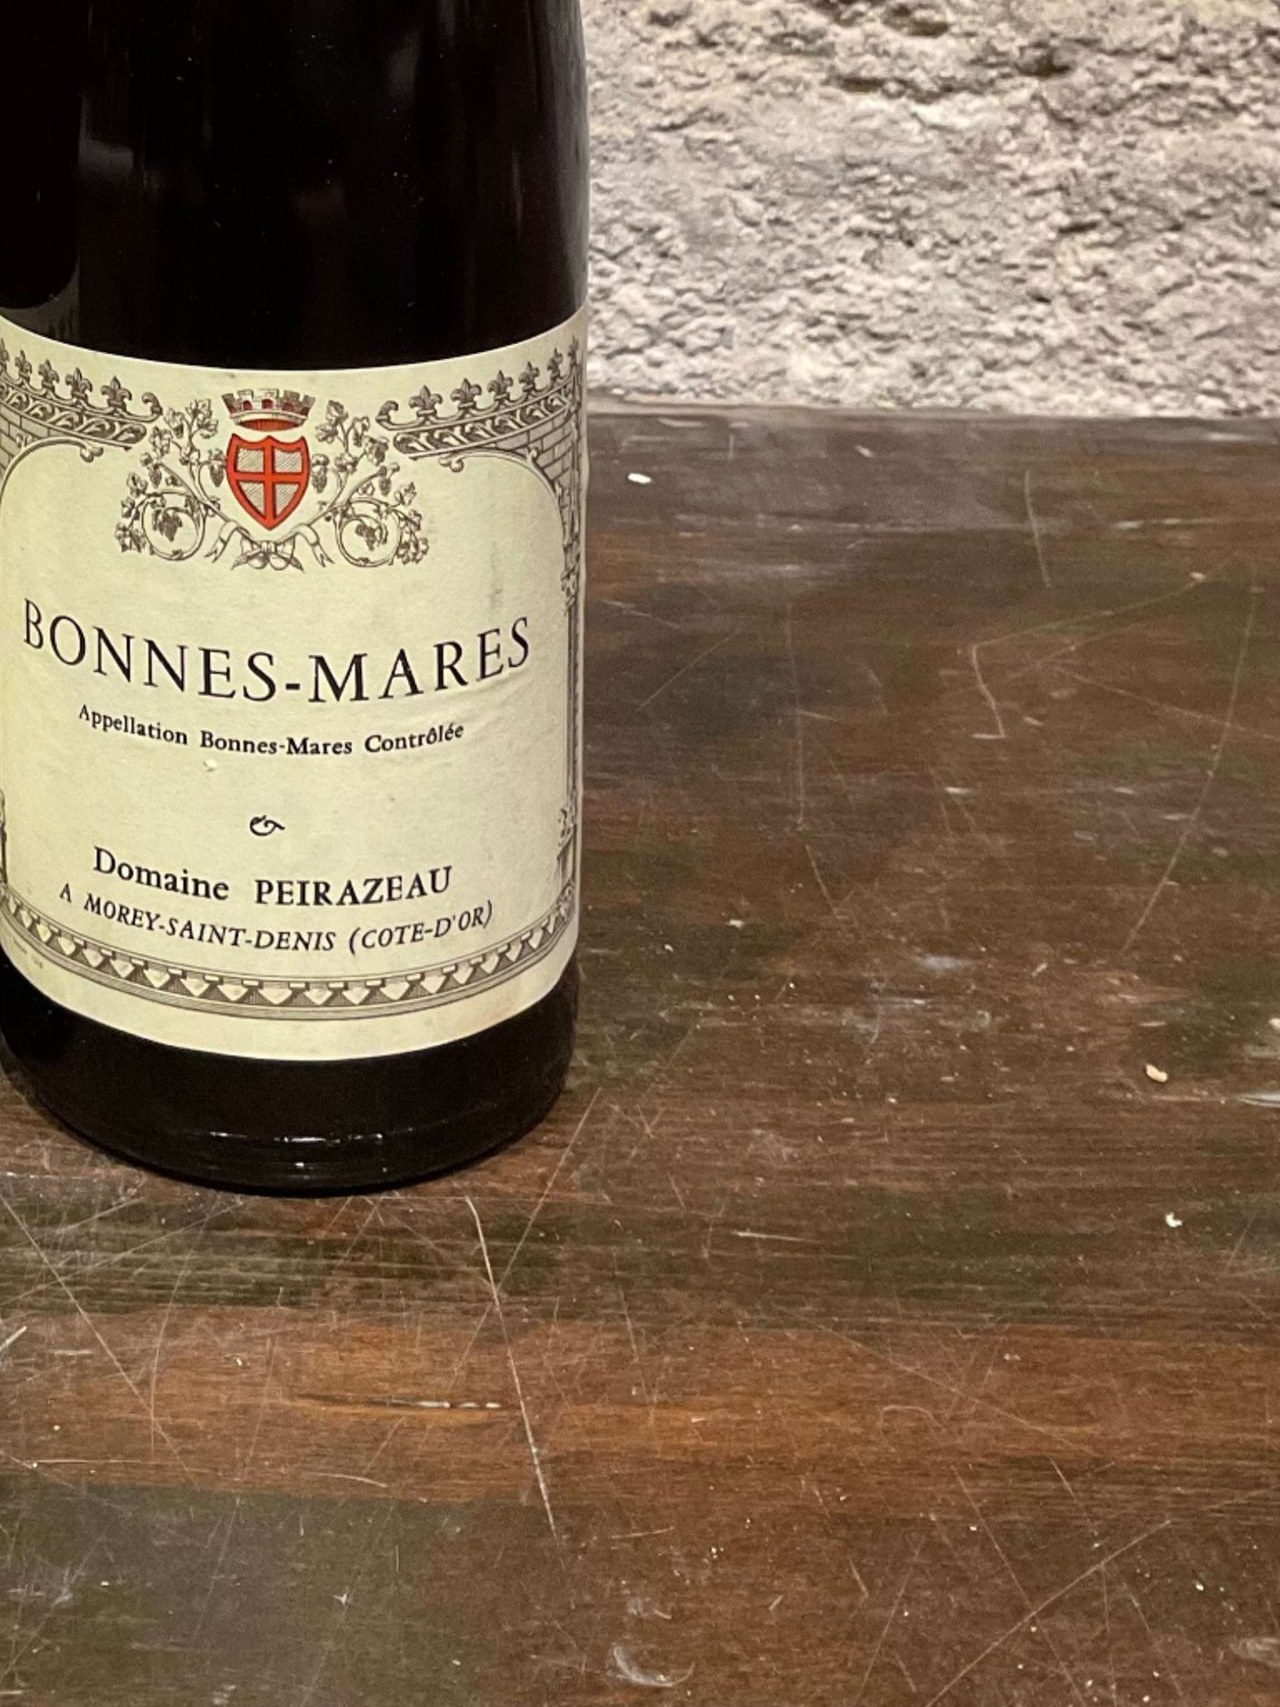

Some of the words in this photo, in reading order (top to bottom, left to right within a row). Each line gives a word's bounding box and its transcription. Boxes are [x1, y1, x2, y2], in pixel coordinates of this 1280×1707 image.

[22, 598, 531, 705] BONNES-MARES
[77, 703, 189, 746] Appellation
[199, 730, 353, 757] Bonnes-Mares
[363, 721, 465, 755] Contrôlée
[92, 845, 230, 902] Domaine
[254, 865, 454, 907] PEIRAZEAU
[59, 882, 74, 903] A
[82, 892, 337, 953] MOREY-SAINT-DENIS
[348, 899, 494, 955] (COTE-D'OR)
